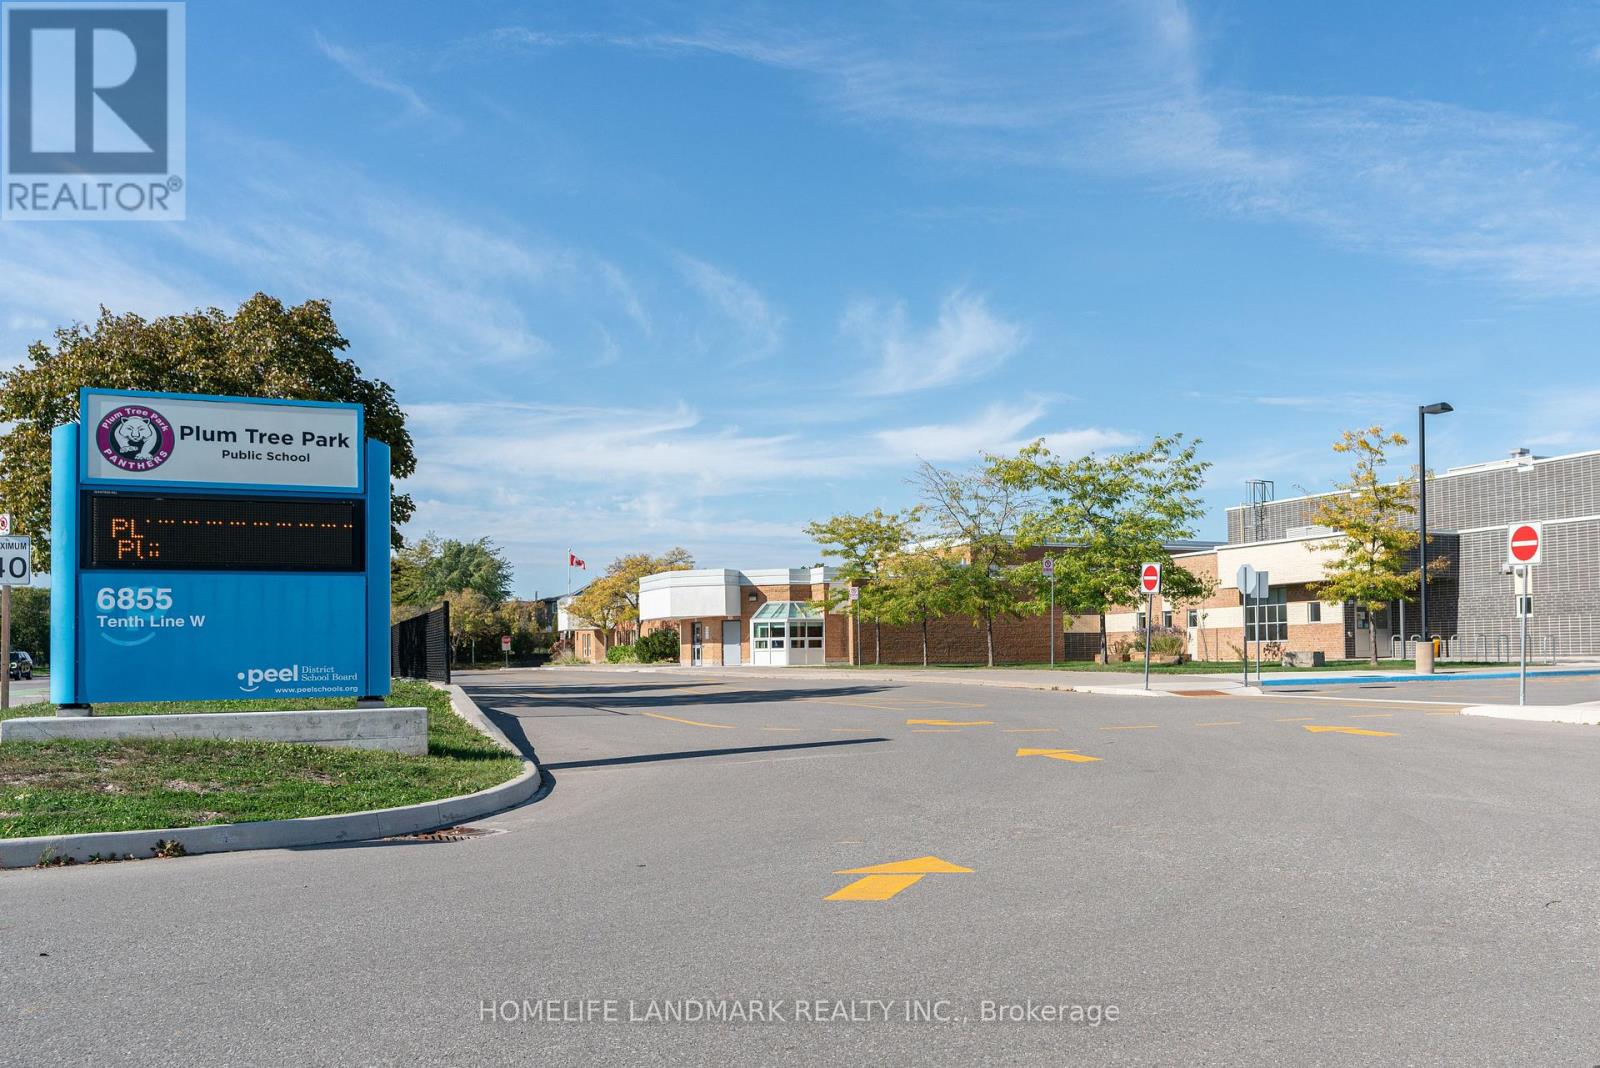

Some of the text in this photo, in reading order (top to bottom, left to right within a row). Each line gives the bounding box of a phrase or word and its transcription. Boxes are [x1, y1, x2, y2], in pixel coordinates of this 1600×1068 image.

[101, 407, 169, 432] Plum Tree Park
[179, 425, 350, 449] Plum Tree Park
[103, 448, 168, 470] PANTHERS
[222, 449, 311, 462] Public School
[0, 542, 27, 550] XIMUM
[97, 587, 173, 610] 6855
[96, 615, 206, 628] Tenth Line W
[247, 664, 299, 687] peel
[301, 665, 335, 674] District
[301, 673, 358, 682] School Board
[274, 685, 359, 694] www.peelschools.org
